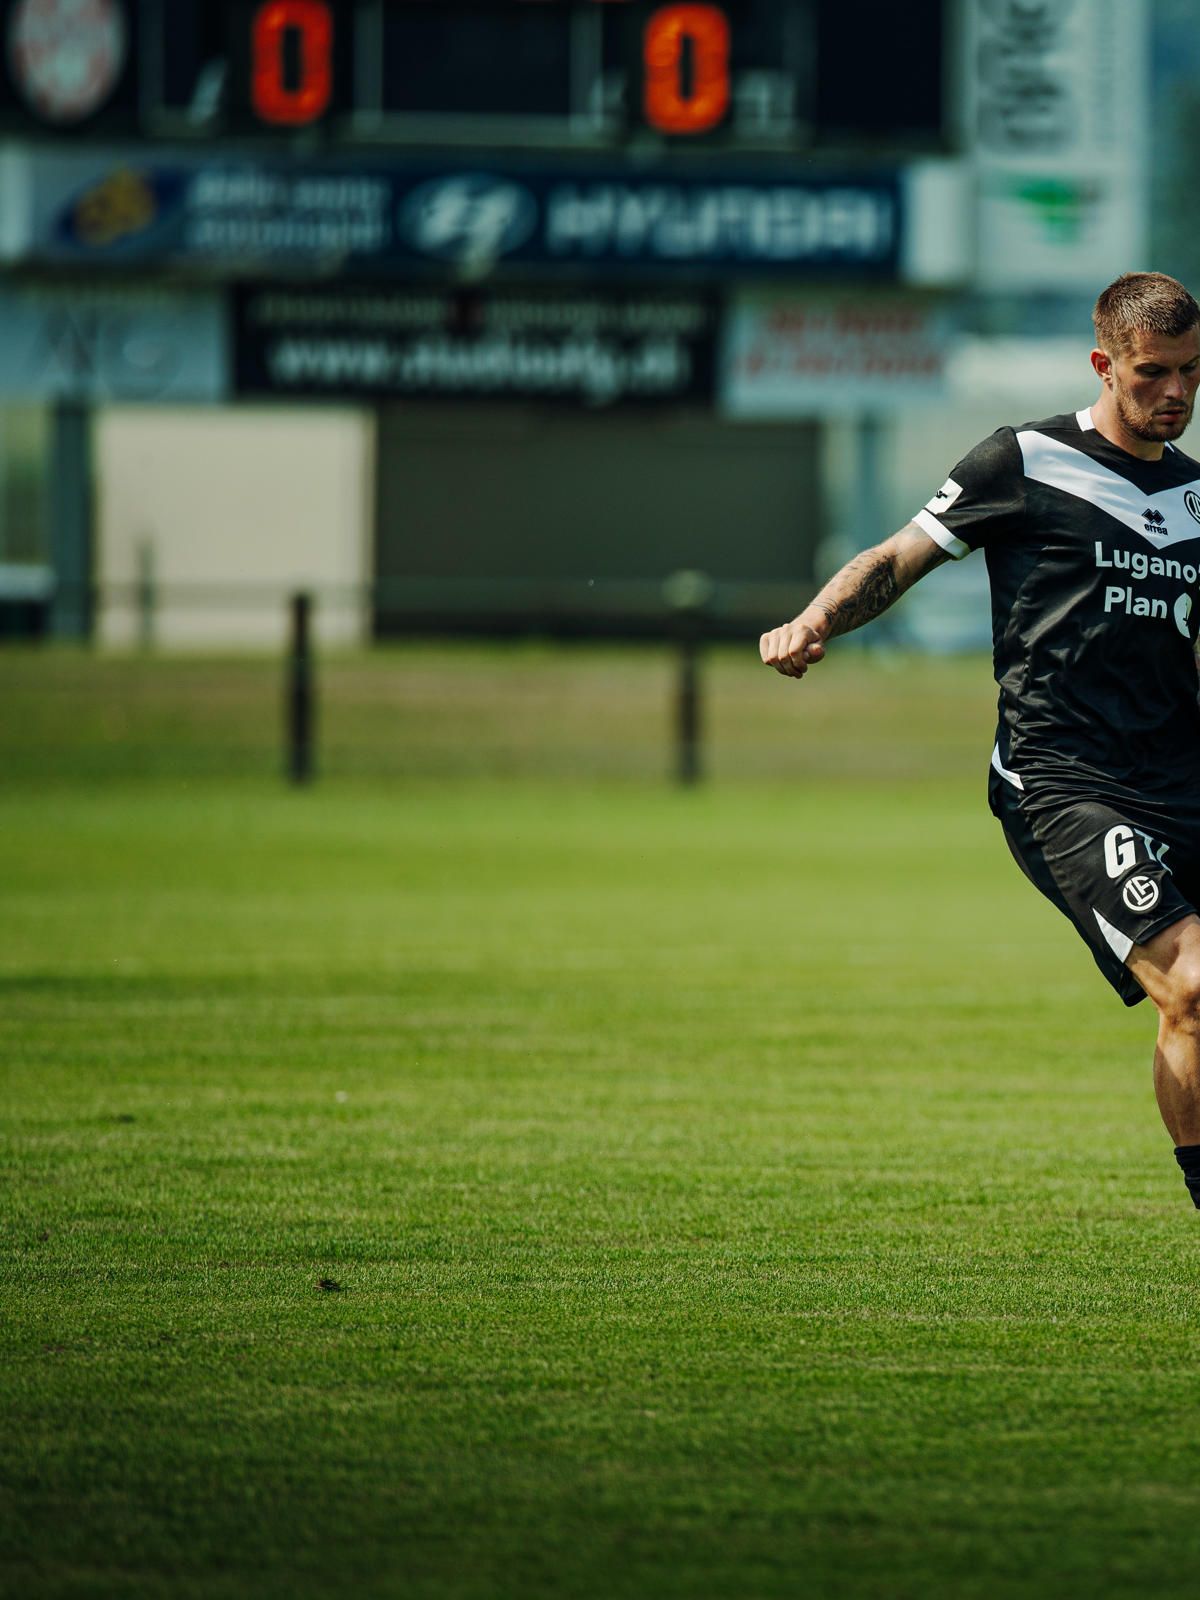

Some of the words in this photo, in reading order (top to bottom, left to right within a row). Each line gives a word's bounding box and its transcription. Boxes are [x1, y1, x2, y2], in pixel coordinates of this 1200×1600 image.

[251, 0, 334, 126] 0
[644, 3, 731, 135] 0
[1104, 586, 1168, 619] Plan
